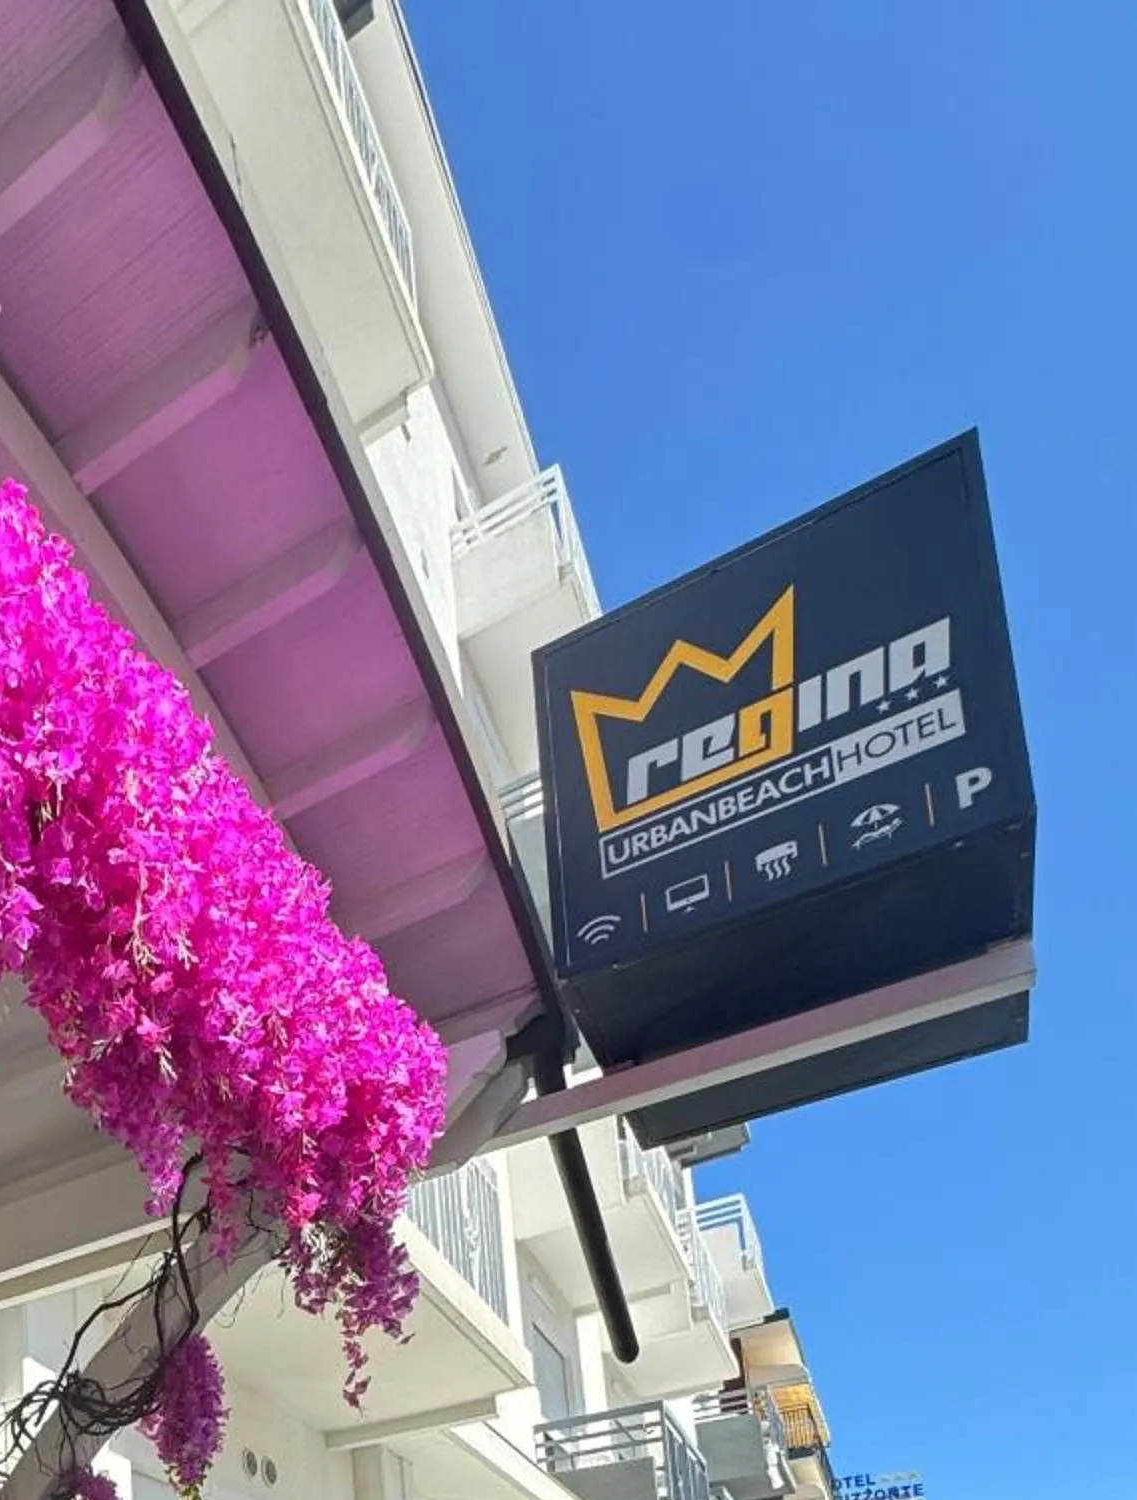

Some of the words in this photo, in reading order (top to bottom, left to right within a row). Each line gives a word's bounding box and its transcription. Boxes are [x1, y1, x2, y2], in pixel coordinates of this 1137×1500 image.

[837, 708, 957, 771] HOTEL
[956, 766, 992, 810] P
[832, 1474, 876, 1491] OTEL
